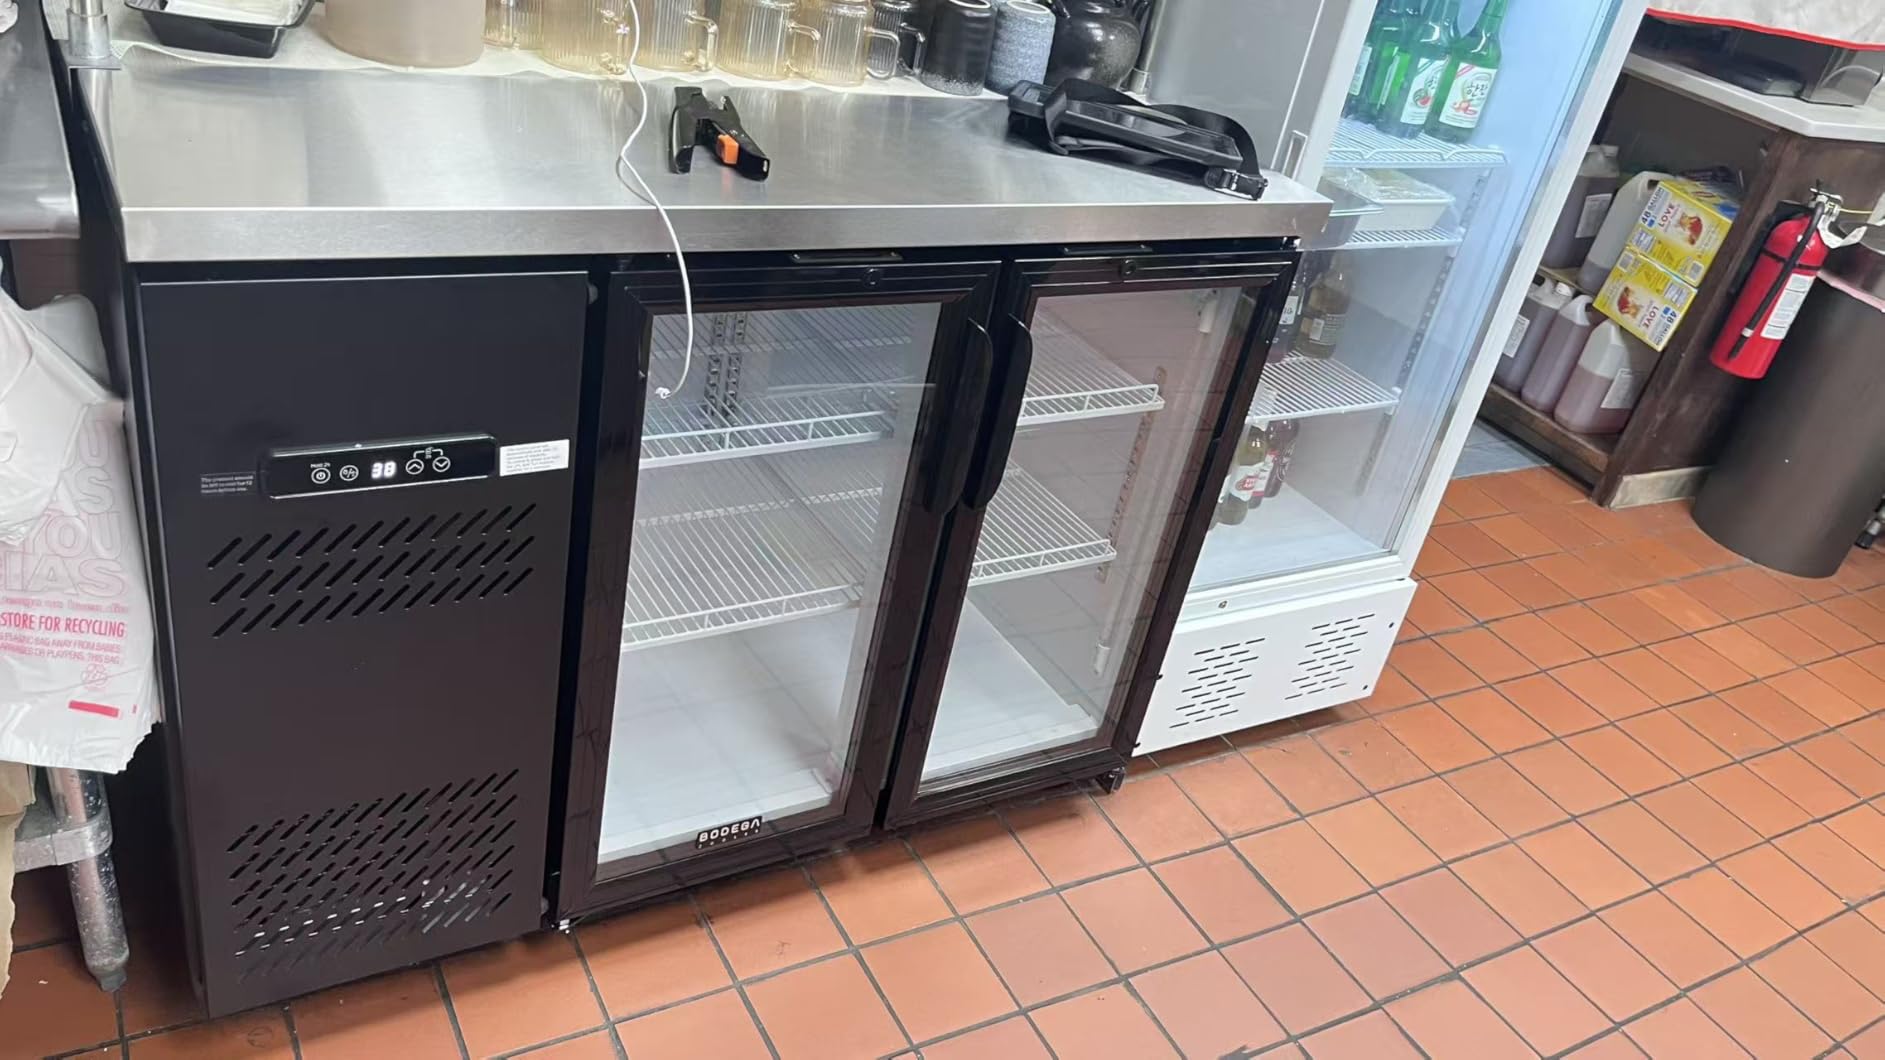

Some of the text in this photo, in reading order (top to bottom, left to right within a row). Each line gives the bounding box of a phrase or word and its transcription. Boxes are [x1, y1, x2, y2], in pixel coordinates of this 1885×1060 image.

[1658, 203, 1675, 228] LOVE
[1643, 305, 1660, 329] LOVE
[370, 460, 397, 480] 38
[0, 611, 126, 638] STORE FOR RECYCLING
[699, 818, 761, 843] BODEGA
